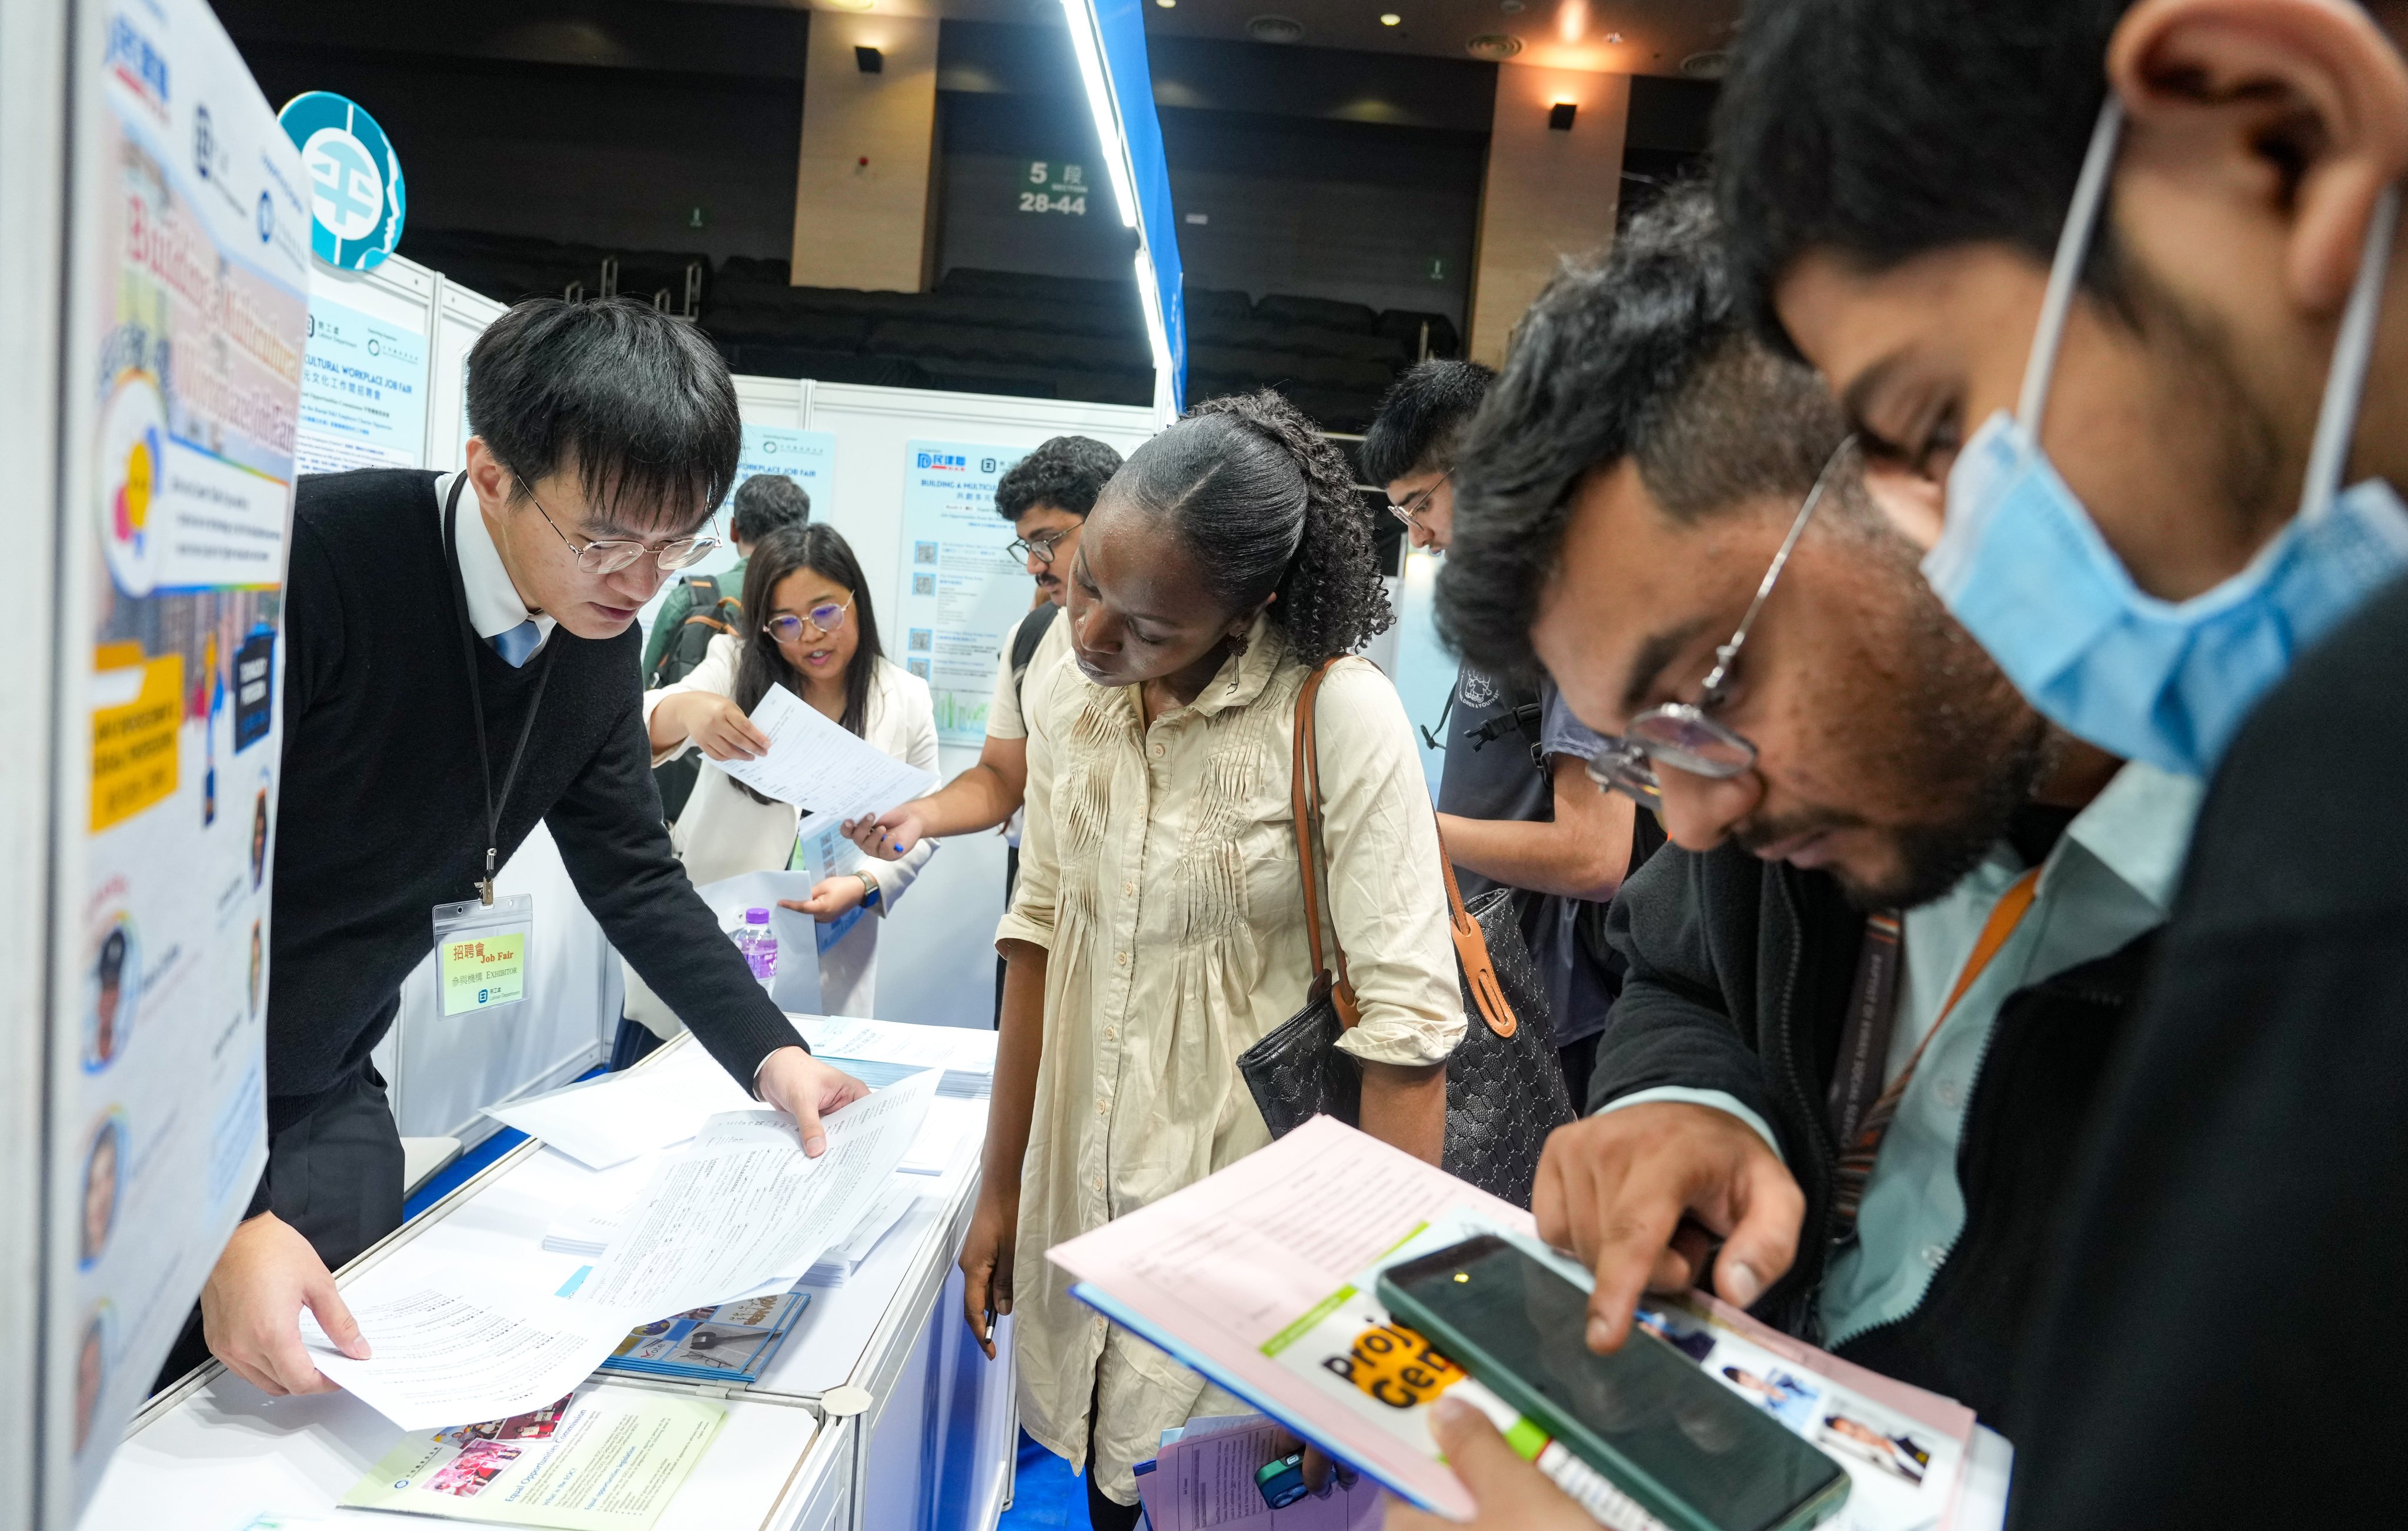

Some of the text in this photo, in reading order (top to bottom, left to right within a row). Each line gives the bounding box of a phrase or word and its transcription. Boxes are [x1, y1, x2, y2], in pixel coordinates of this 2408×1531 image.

[1030, 162, 1048, 184] 5
[1019, 193, 1086, 215] 28-44
[342, 365, 383, 386] WORKPLACE
[385, 378, 398, 390] JOB
[399, 382, 412, 394] FAIR
[784, 468, 798, 476] JOB
[921, 479, 954, 488] BUILDING
[1478, 698, 1495, 708] YOUTH
[453, 942, 485, 961] 招聘會
[480, 951, 514, 963] Job Fair
[452, 972, 483, 988] 參與機構
[1322, 1312, 1412, 1383] Proj
[504, 1485, 527, 1502] Equal
[519, 1444, 562, 1484] Opportunities
[553, 1409, 588, 1443] Commission
[542, 1493, 557, 1505] What
[562, 1467, 578, 1480] EOC?
[584, 1446, 638, 1510] Equal opportunities legislation
